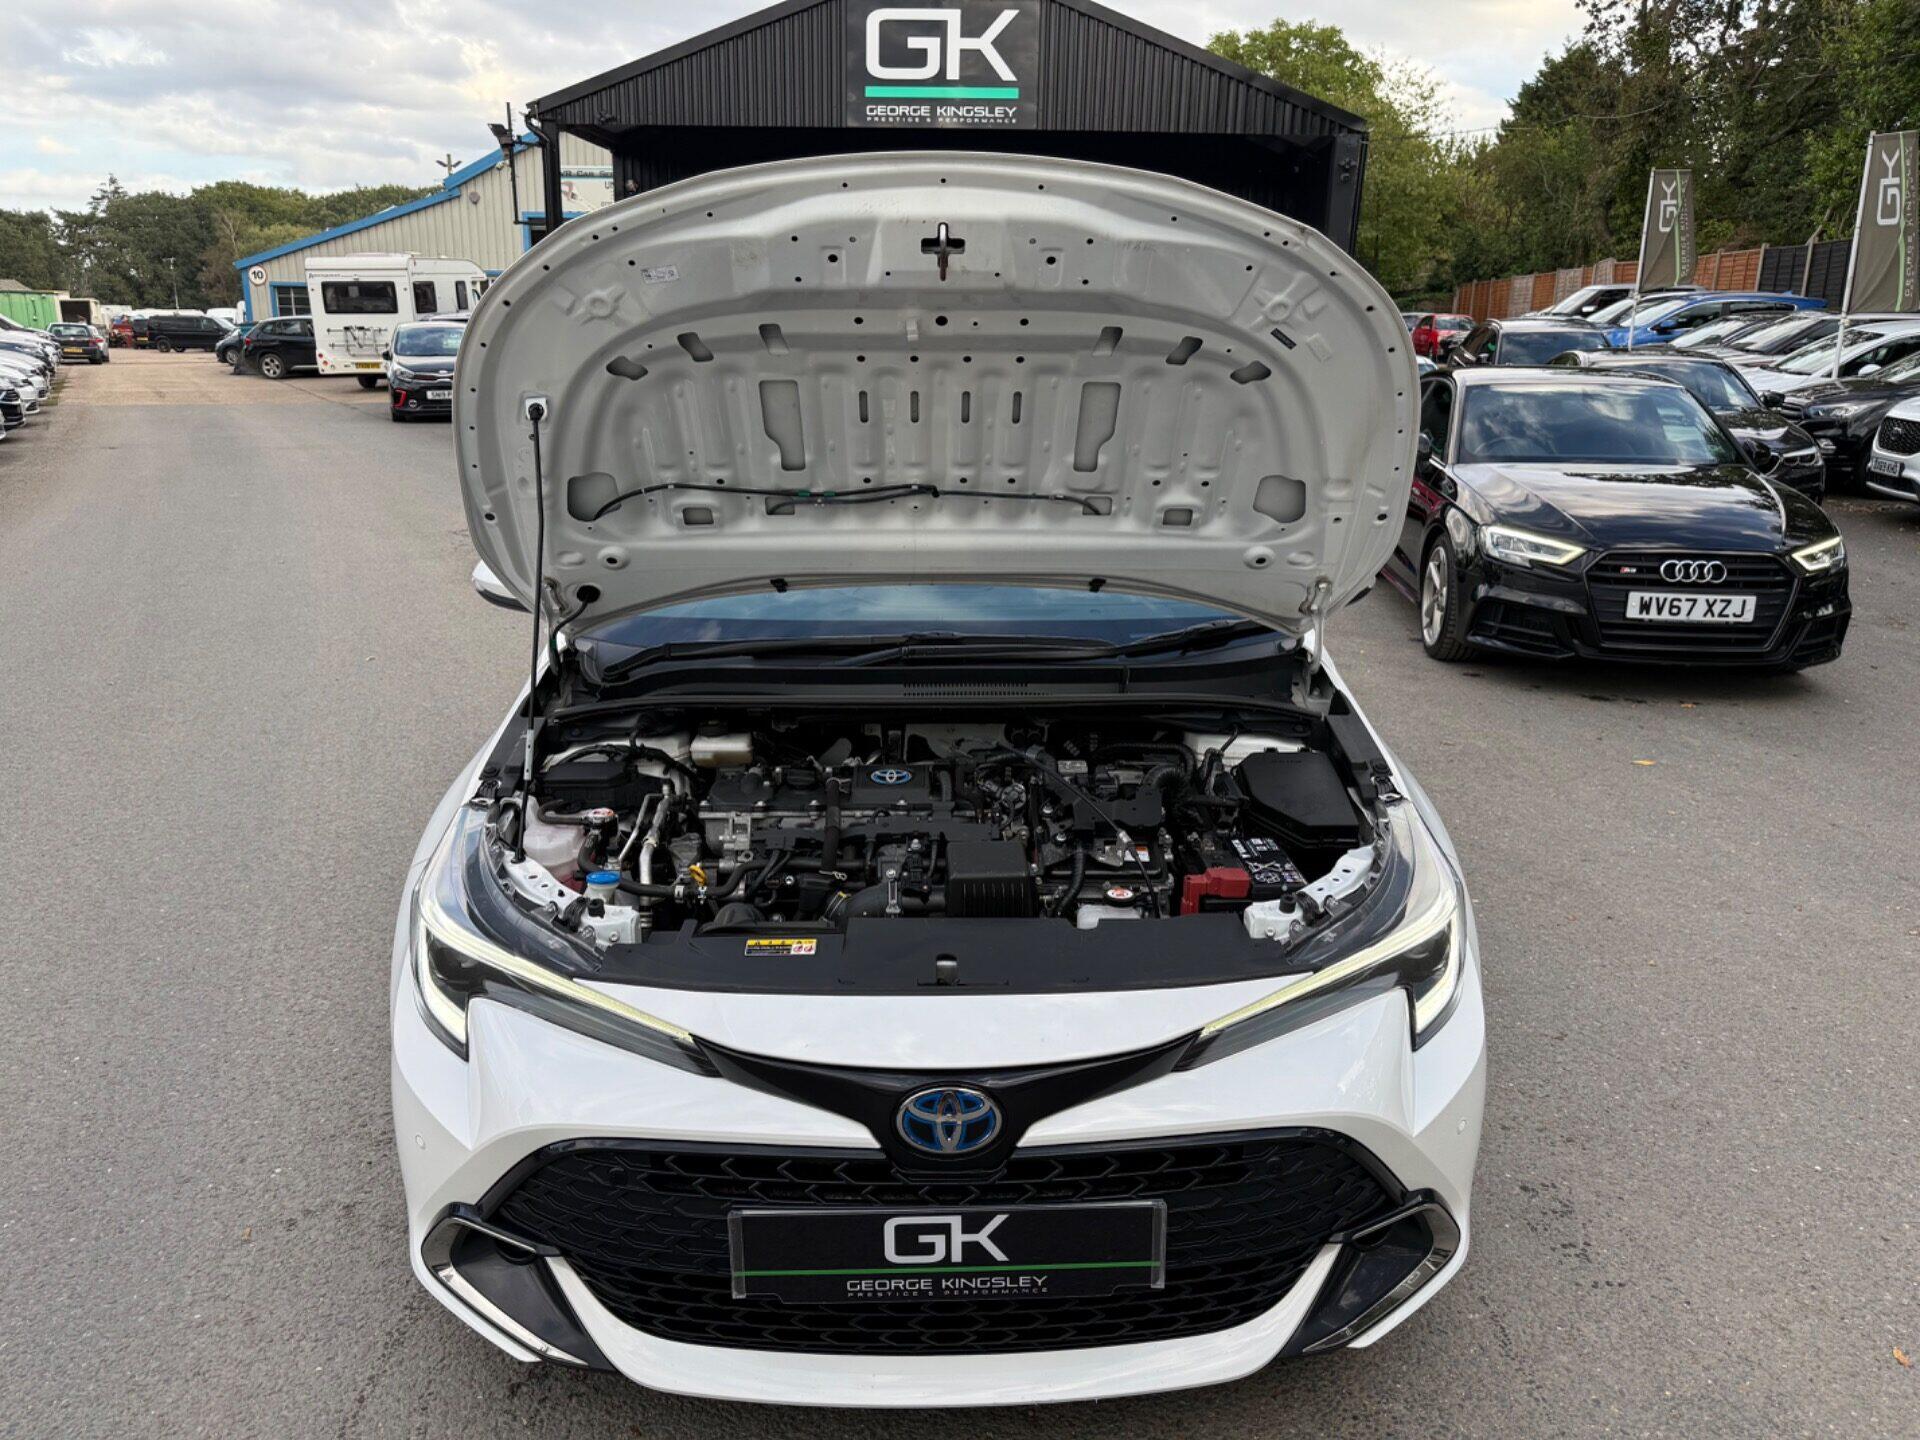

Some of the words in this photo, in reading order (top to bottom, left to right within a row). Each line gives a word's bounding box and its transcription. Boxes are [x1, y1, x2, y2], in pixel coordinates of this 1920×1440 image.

[866, 8, 1020, 81] GK
[866, 105, 931, 117] GEORGE
[936, 106, 1017, 118] KINGSLEY
[1876, 149, 1900, 226] GK
[1659, 180, 1677, 232] GK
[251, 270, 264, 279] 10
[1639, 596, 1698, 617] WV67
[1703, 599, 1747, 618] XZJ
[883, 1214, 1010, 1264] GK
[847, 1279, 933, 1291] GEORGE
[942, 1275, 1048, 1289] KINGSLEY
[944, 1287, 1048, 1295] PERFORMANCE
